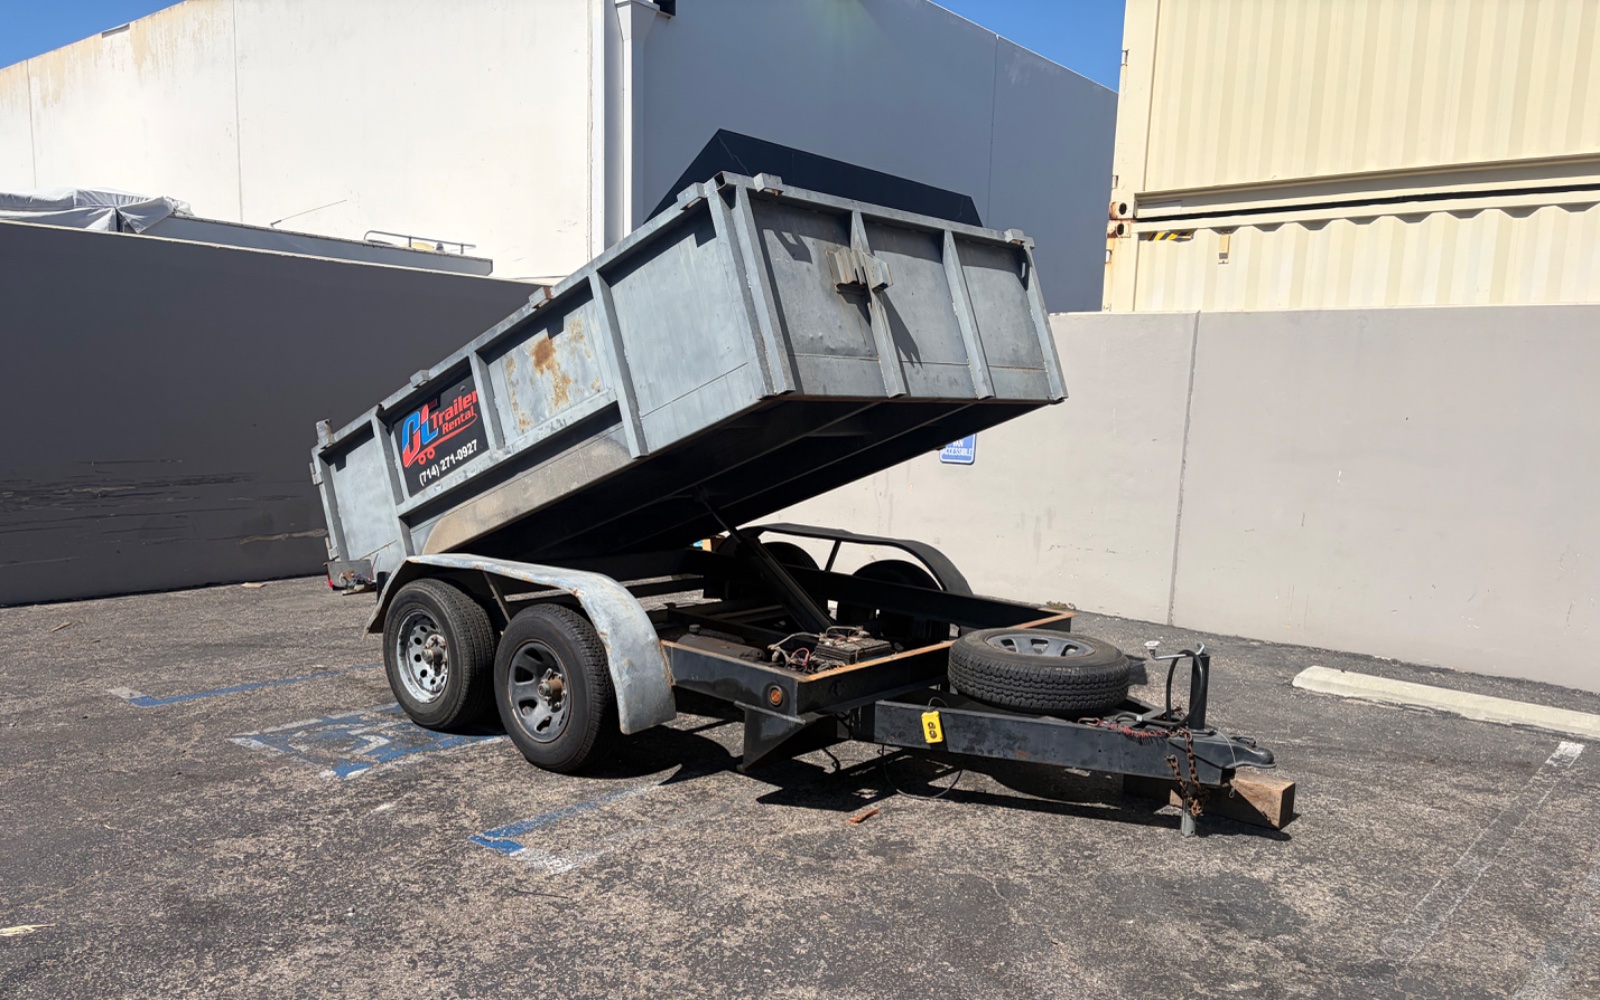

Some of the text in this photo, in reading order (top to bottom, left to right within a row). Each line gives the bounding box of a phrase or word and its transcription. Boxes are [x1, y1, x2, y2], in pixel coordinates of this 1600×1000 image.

[430, 390, 477, 429] Trailer
[442, 406, 475, 435] Rental
[419, 439, 477, 486] (714) 271-0927
